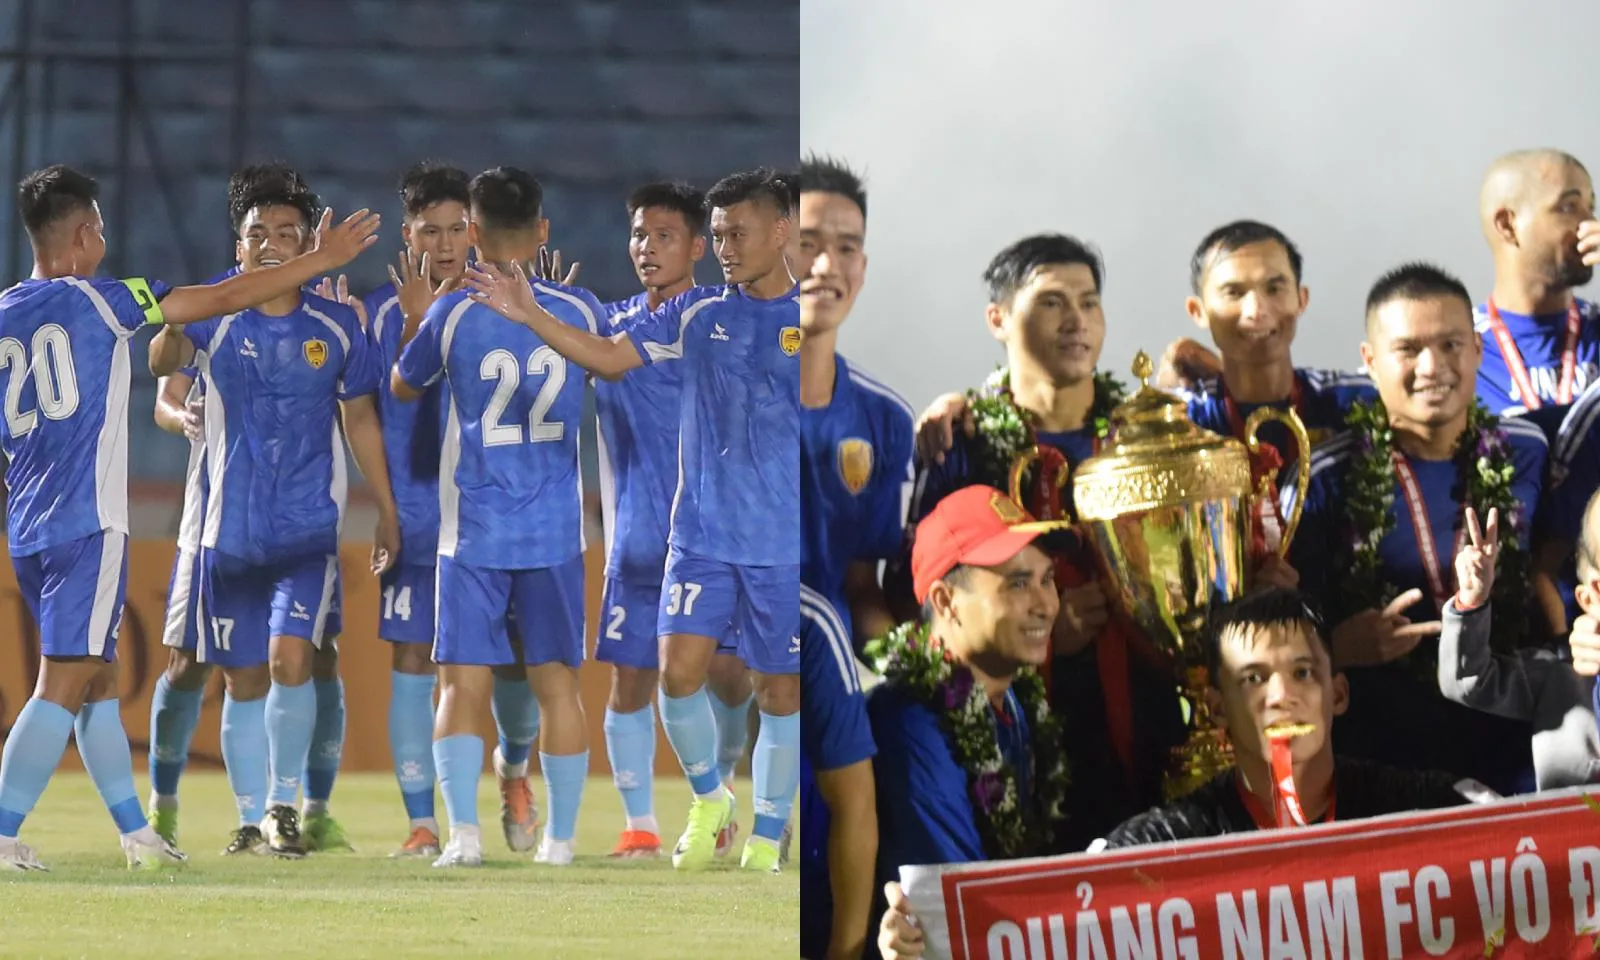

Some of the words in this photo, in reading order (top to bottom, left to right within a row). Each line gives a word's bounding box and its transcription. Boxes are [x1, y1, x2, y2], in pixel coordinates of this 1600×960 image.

[0, 323, 80, 439] 20
[480, 345, 567, 448] 22
[383, 585, 412, 621] 14
[666, 583, 702, 616] 37
[211, 615, 235, 651] 17
[605, 606, 626, 641] 2
[1215, 875, 1365, 960] NAM
[1379, 864, 1455, 960] FC
[1470, 836, 1550, 949] VÔ
